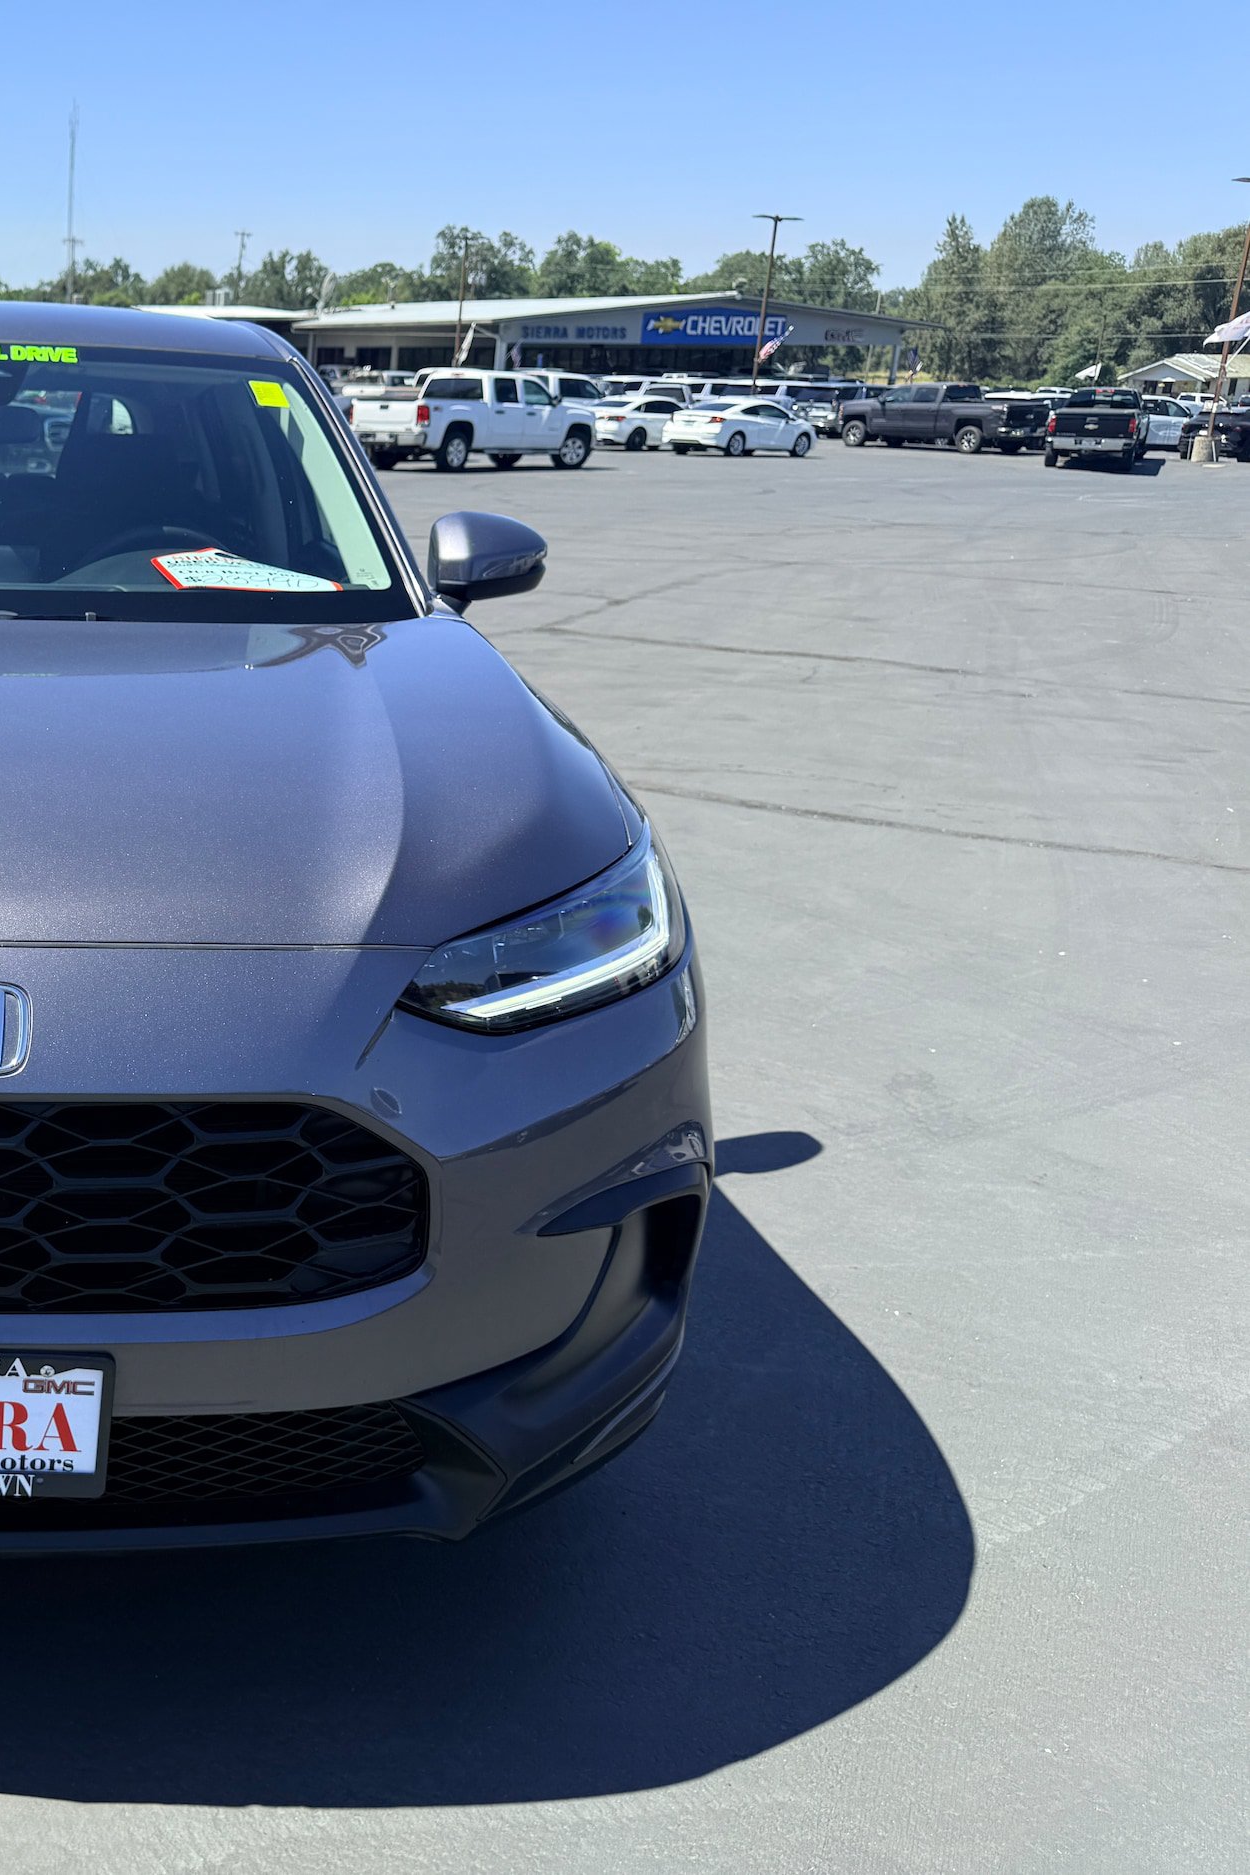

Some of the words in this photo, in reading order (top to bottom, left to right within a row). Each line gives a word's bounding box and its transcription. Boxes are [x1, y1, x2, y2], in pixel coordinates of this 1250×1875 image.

[521, 325, 568, 339] SIERRA
[575, 325, 627, 340] MOTORS
[686, 315, 787, 336] CHEVROLET
[10, 345, 78, 363] DRIVE
[22, 1378, 95, 1396] GMC
